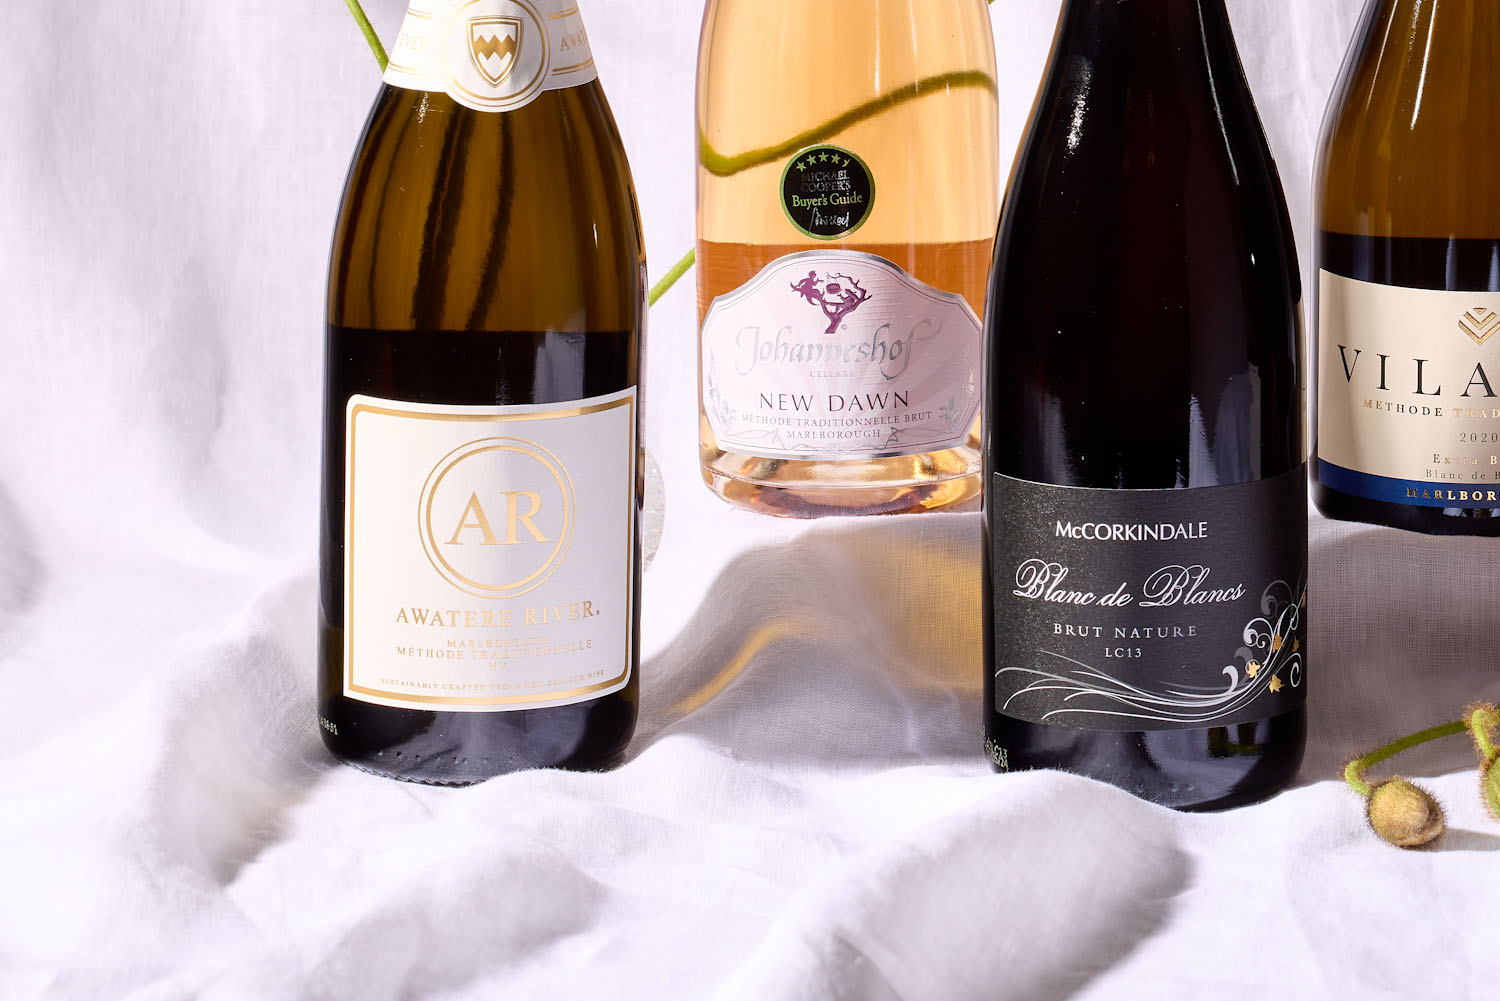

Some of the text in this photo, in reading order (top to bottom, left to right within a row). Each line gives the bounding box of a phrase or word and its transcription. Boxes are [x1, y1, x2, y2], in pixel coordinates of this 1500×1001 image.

[791, 191, 863, 210] Buyer's Guide
[735, 318, 943, 381] Johanneshof
[760, 390, 909, 412] NEW DAWN
[904, 411, 933, 423] BRUT
[786, 429, 881, 440] MARLBOROUGH
[1459, 432, 1499, 443] 2020
[1425, 469, 1463, 480] Blanc
[1471, 471, 1486, 480] de
[444, 489, 551, 546] AR
[1055, 520, 1208, 541] McCORKINDALE
[1013, 558, 1246, 607] Blanc de Blancs
[396, 606, 513, 628] AWATERE
[1054, 622, 1197, 639] BRUT NATURE
[1105, 647, 1142, 658] LC13
